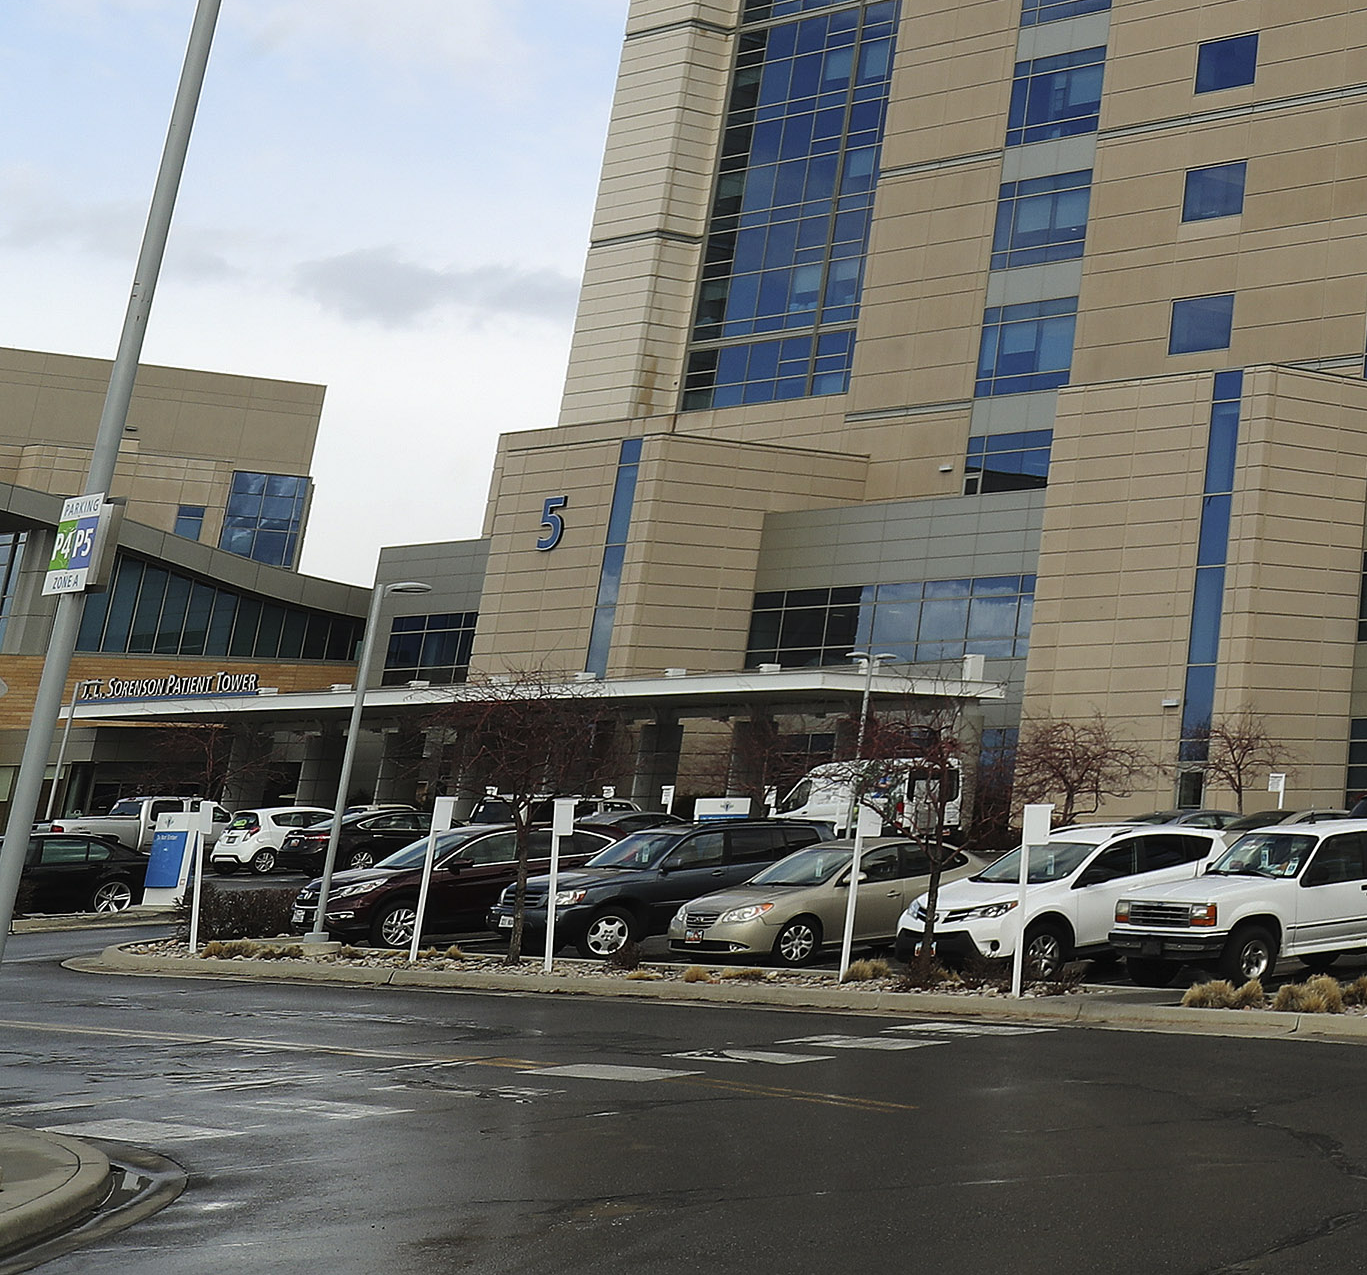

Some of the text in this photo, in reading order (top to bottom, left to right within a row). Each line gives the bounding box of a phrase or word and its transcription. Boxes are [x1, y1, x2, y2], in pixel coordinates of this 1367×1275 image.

[64, 498, 100, 517] PARKING
[536, 495, 568, 552] 5
[51, 527, 95, 561] P4 P5
[52, 574, 79, 590] ZONE A
[107, 677, 166, 698] SORENSON
[167, 674, 213, 695] PATIENT
[216, 671, 259, 692] TOWER
